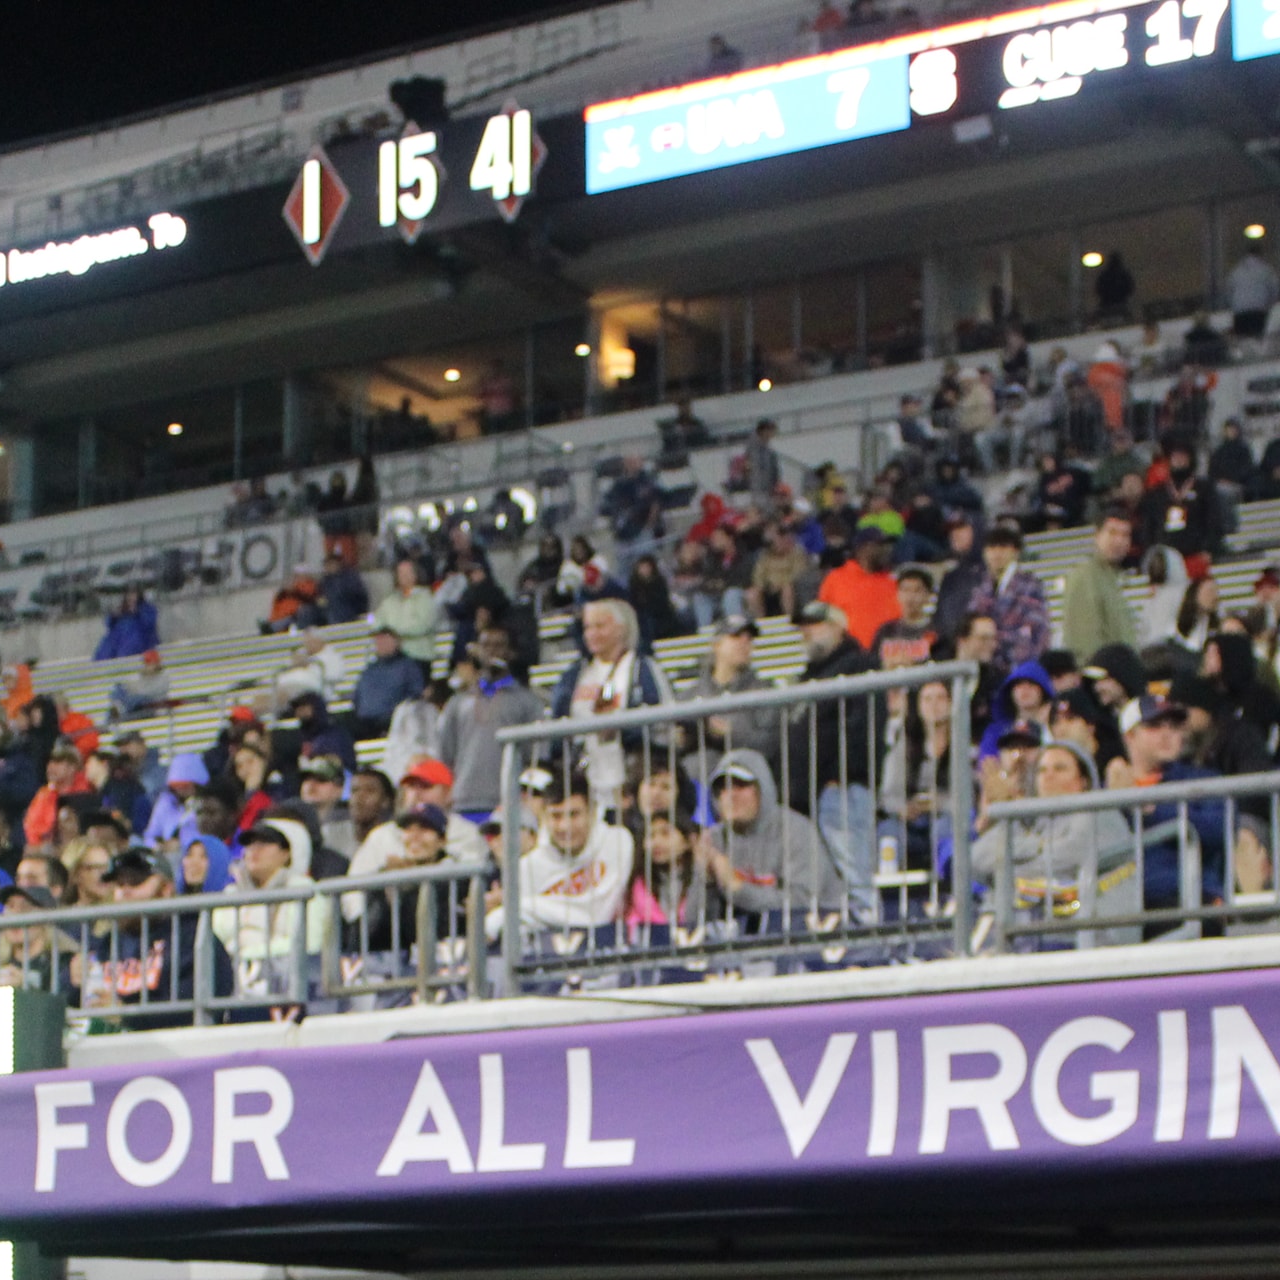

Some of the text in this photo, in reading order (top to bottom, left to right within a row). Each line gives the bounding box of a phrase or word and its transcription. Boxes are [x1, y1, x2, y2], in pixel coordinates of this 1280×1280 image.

[826, 67, 870, 131] 7
[378, 131, 438, 227] 15
[469, 108, 532, 200] 41
[34, 1066, 294, 1192] FOR
[376, 1048, 636, 1178] ALL
